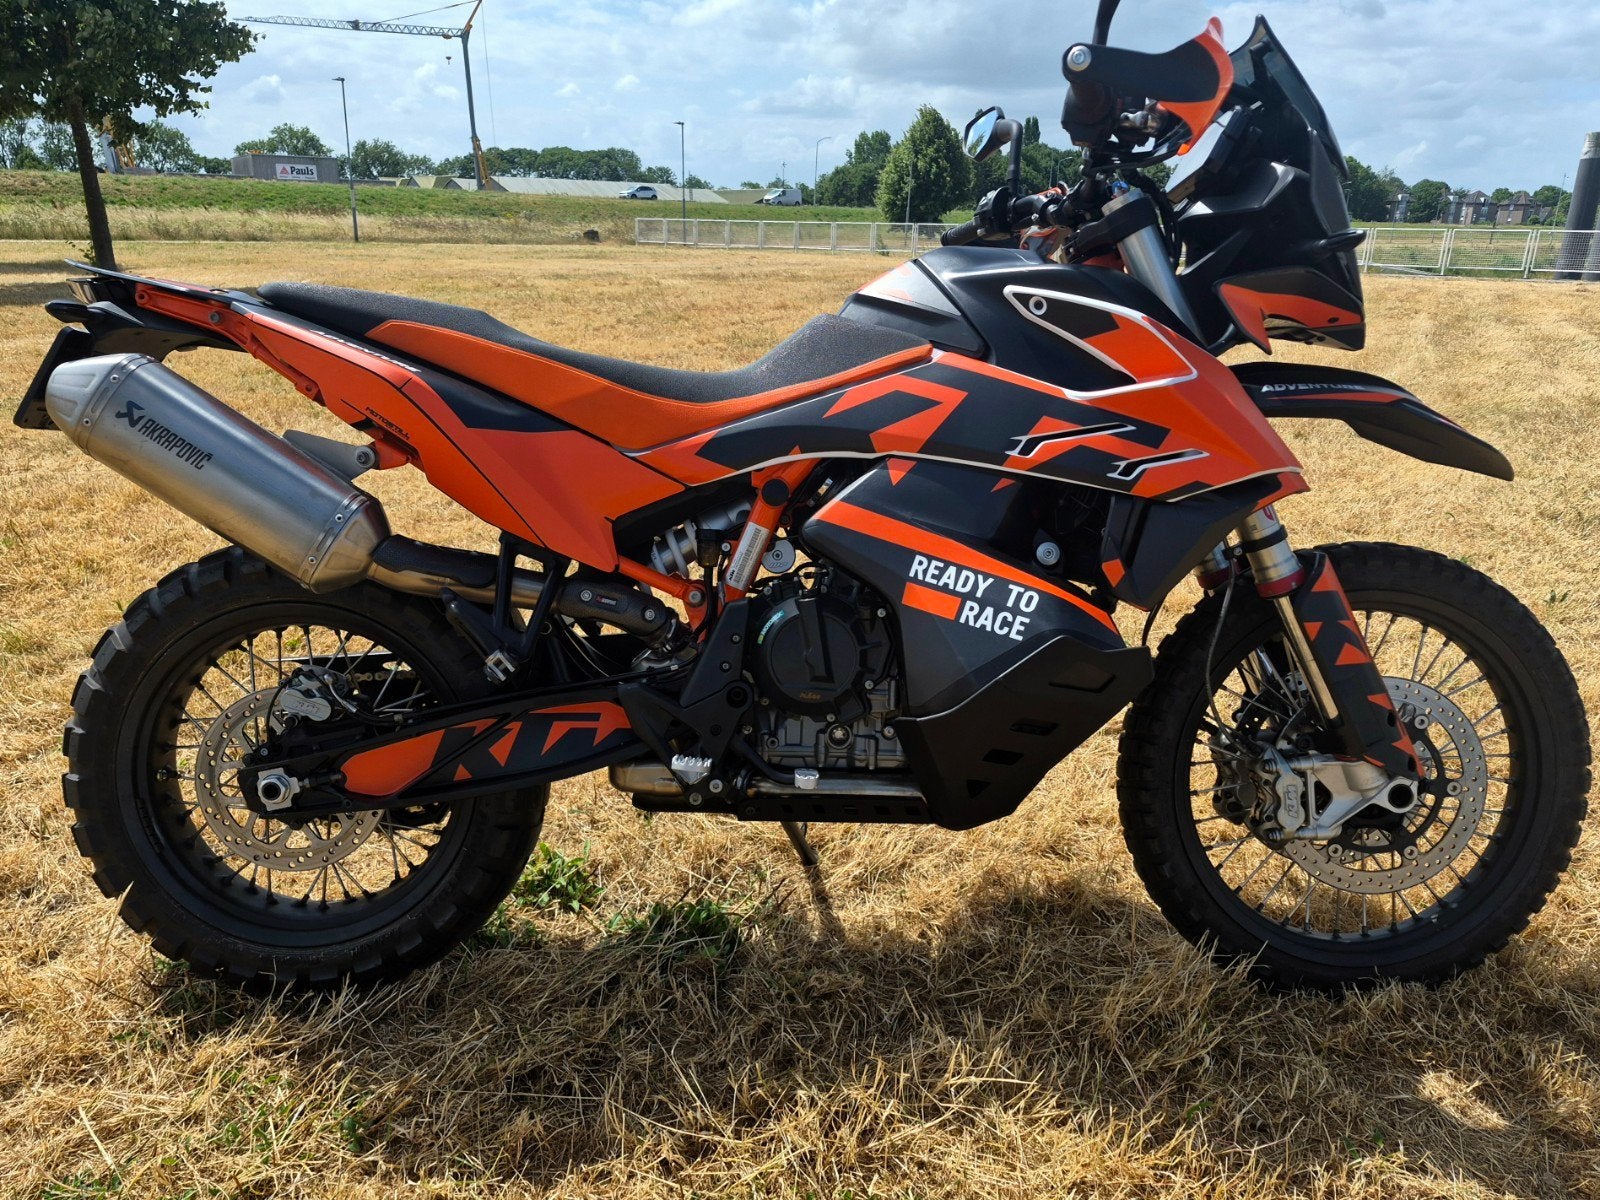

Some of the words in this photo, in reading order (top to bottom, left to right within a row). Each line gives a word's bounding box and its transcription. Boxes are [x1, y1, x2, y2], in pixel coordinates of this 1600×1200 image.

[290, 166, 314, 175] Pauls
[1261, 383, 1366, 393] ADVENTURE
[909, 554, 994, 598] READY
[1006, 584, 1040, 613] TO
[959, 600, 1030, 641] RACE
